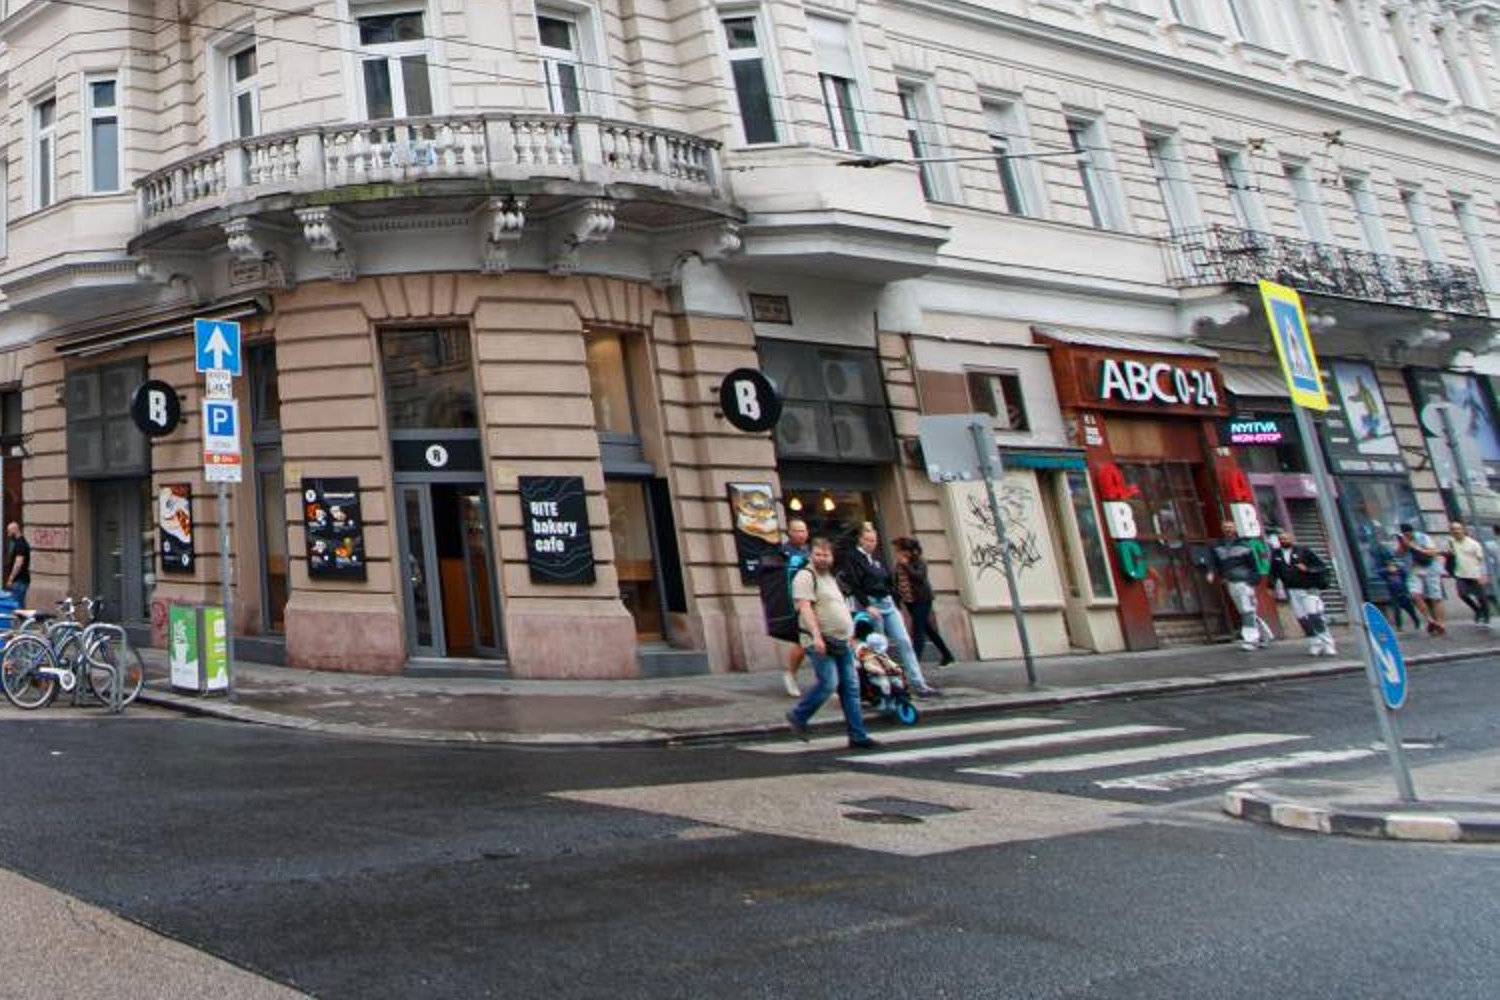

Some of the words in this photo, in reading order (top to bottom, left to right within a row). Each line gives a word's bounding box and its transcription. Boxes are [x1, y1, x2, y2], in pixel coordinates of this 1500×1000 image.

[1102, 359, 1179, 404] ABC
[1174, 366, 1218, 406] 0-24
[149, 390, 167, 427] B
[734, 379, 761, 421] B
[213, 408, 228, 432] P
[532, 518, 577, 537] bakery
[535, 536, 565, 552] cafe
